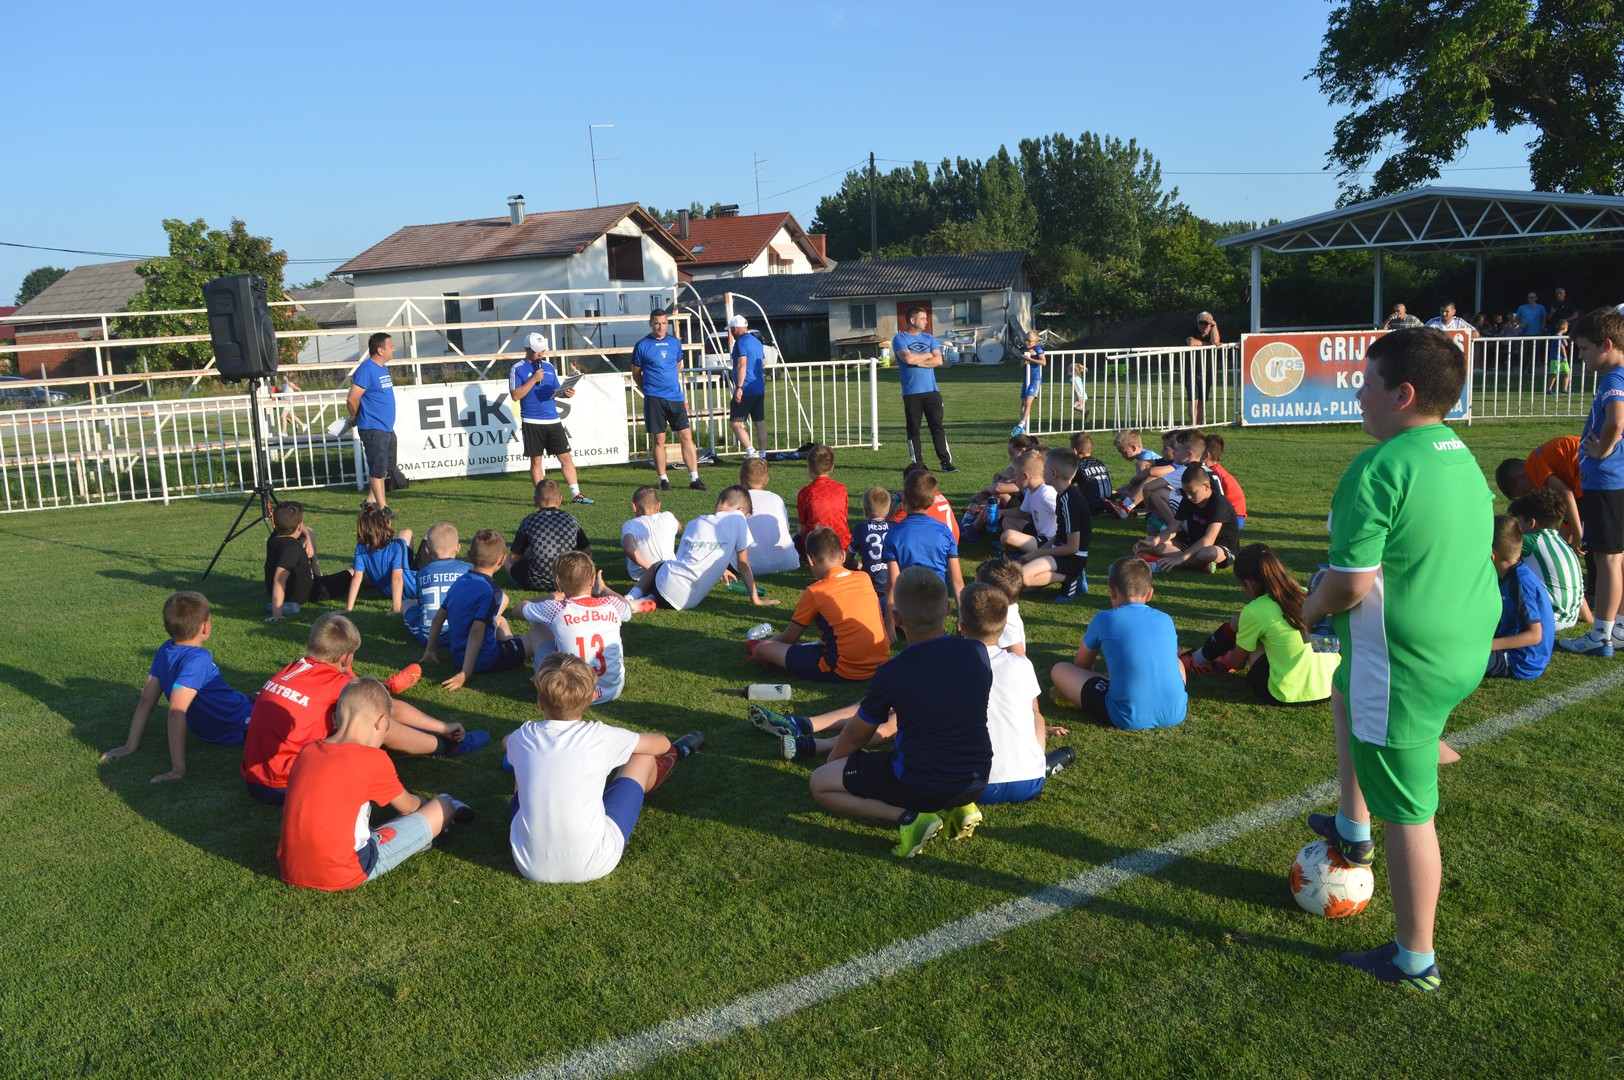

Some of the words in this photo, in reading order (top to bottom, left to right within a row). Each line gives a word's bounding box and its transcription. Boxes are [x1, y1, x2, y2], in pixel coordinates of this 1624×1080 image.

[1336, 370, 1365, 389] KO
[397, 459, 465, 471] OMATIZACIJA
[865, 531, 888, 560] 3
[563, 610, 589, 626] Red
[591, 610, 619, 624] Bulls
[575, 633, 607, 677] 13
[262, 680, 310, 707] VATSKA
